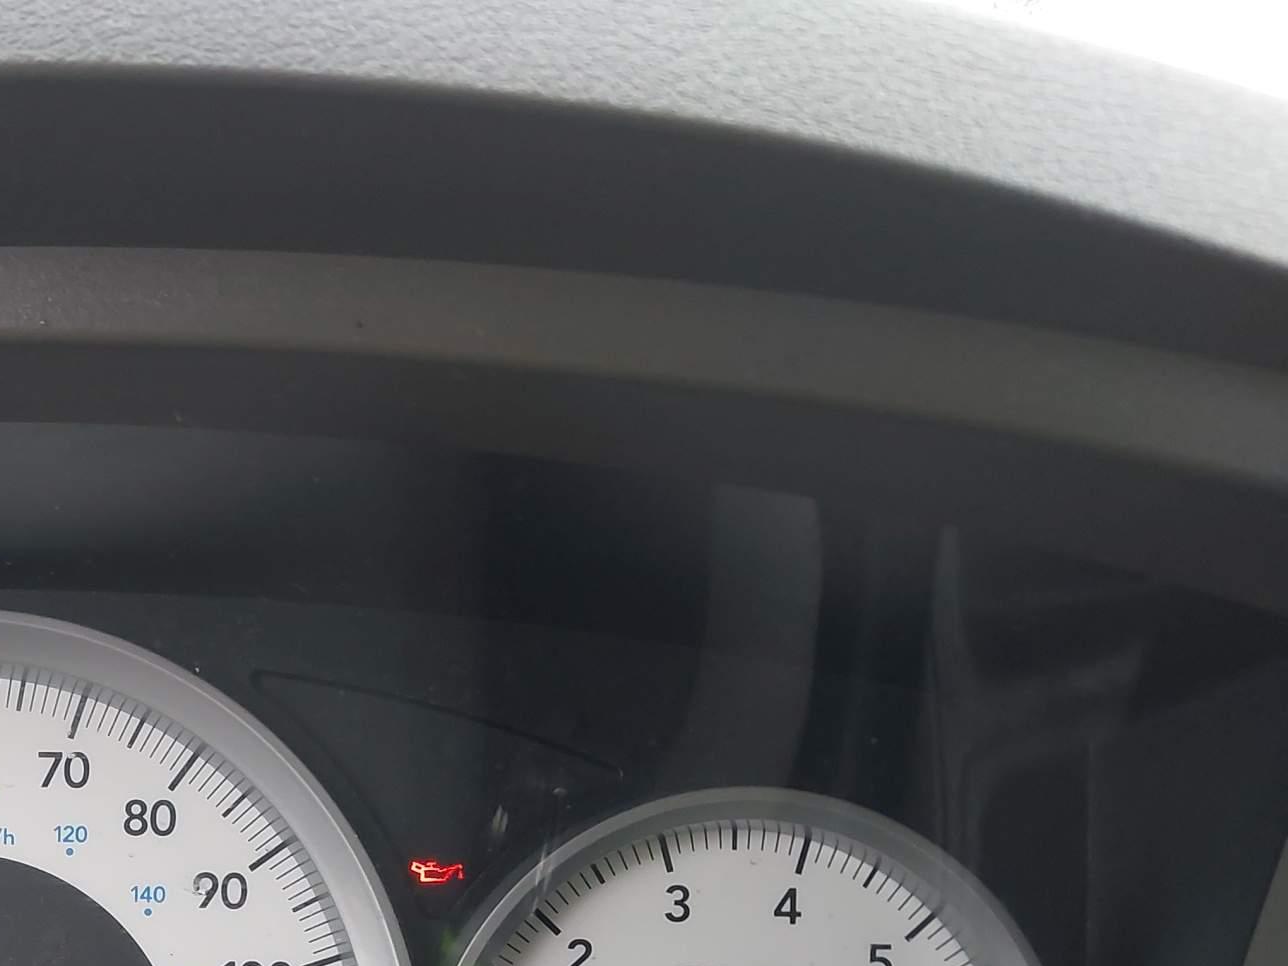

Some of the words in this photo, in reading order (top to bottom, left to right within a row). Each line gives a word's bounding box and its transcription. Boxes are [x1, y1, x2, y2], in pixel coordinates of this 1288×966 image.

[39, 752, 89, 788] 70
[54, 825, 89, 847] 120
[124, 800, 176, 836] 80
[131, 884, 168, 903] 140
[194, 873, 248, 909] 90
[665, 885, 690, 922] 3
[774, 888, 801, 924] 4
